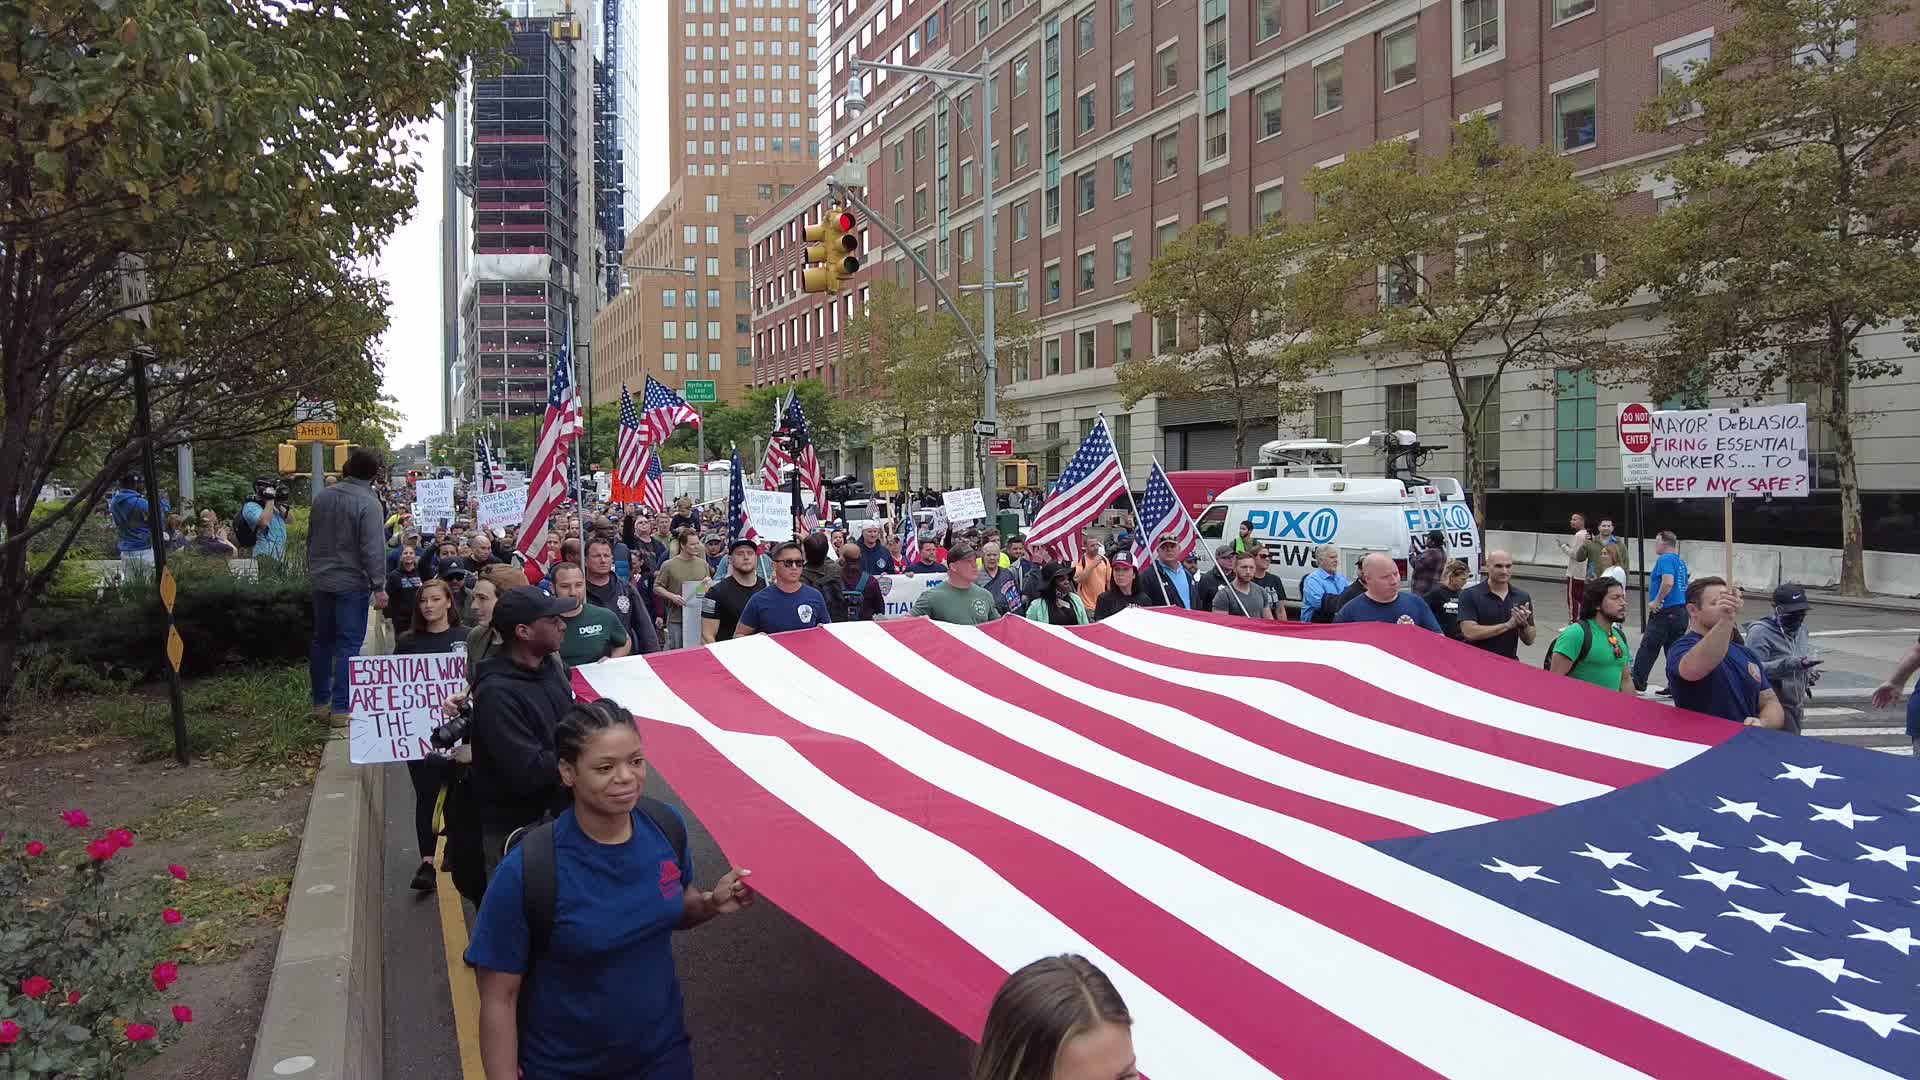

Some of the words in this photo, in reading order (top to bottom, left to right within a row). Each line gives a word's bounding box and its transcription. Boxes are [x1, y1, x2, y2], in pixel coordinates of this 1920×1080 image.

[1623, 412, 1633, 422] DO
[1634, 412, 1649, 422] NOT
[301, 426, 333, 436] AHEAD
[1651, 417, 1708, 434] MAYOR
[1625, 434, 1649, 445] ENTER
[1653, 437, 1709, 451] FIRING
[1716, 436, 1798, 451] ESSENTIAL
[1762, 455, 1792, 468] TO
[1655, 476, 1697, 491] KEEP
[1706, 476, 1742, 492] NYC
[350, 658, 435, 685] ESSENTIAL
[350, 686, 384, 713] ARE
[368, 711, 415, 738] THE
[391, 737, 410, 759] IS
